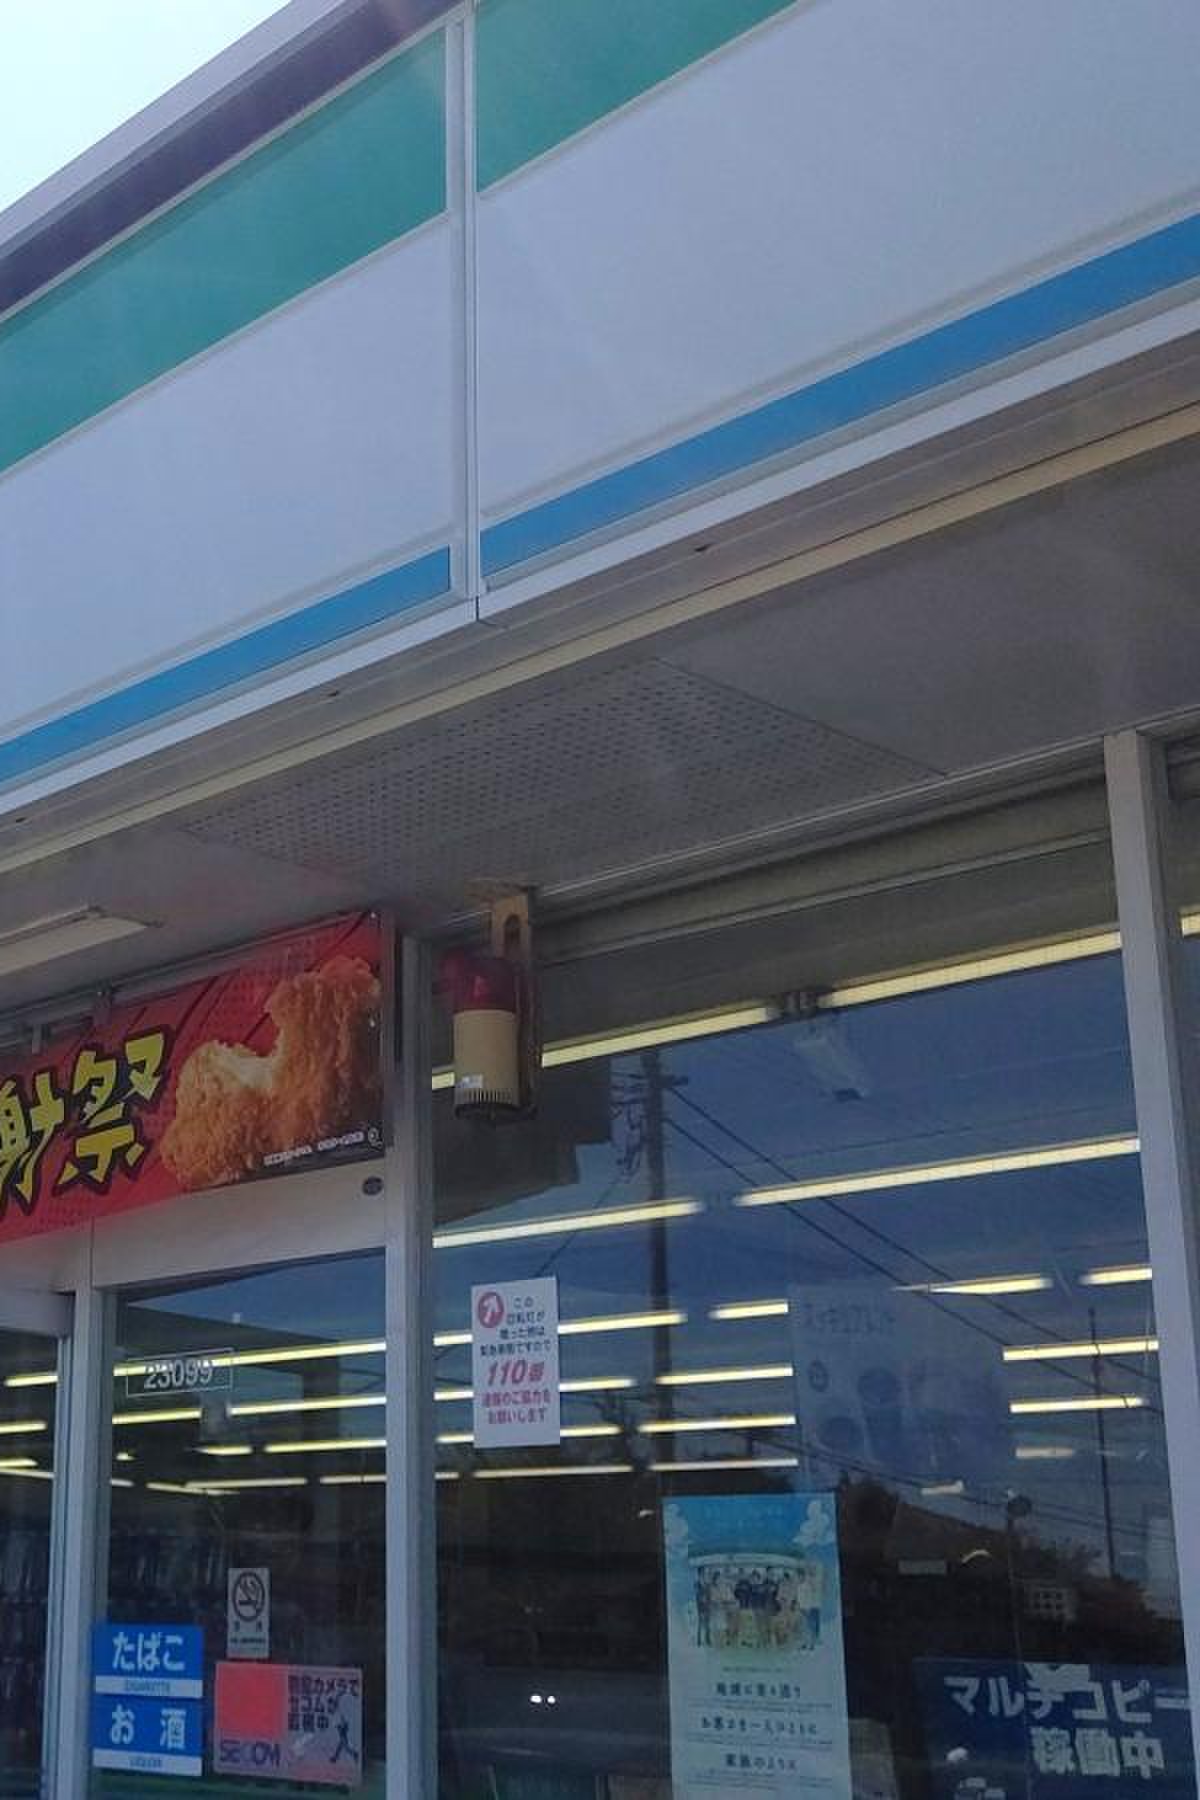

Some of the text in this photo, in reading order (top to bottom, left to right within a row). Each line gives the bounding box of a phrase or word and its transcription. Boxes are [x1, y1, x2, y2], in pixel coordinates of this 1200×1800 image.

[143, 1358, 213, 1389] 23099
[111, 1630, 186, 1672] たばこ
